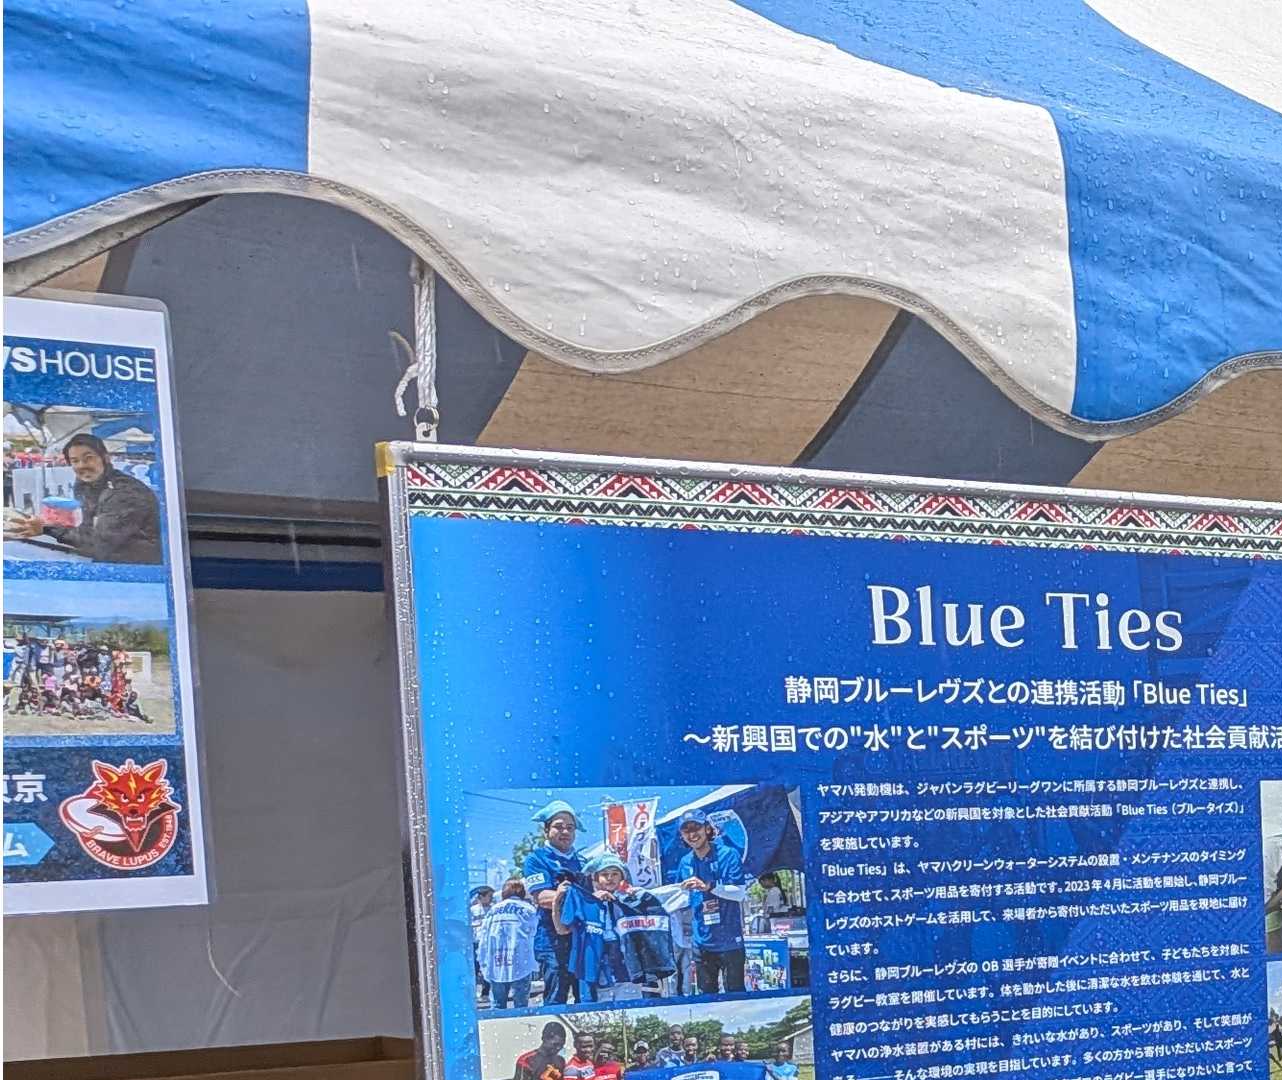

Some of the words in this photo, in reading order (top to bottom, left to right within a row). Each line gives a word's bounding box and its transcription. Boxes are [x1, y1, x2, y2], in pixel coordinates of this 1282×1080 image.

[866, 584, 1026, 649] Blue
[1046, 592, 1183, 652] Ties
[3, 771, 49, 804] 京
[85, 839, 120, 865] BRAVE
[123, 848, 160, 866] LUPUS
[820, 835, 920, 851] を実施しています。
[826, 941, 880, 957] ています。
